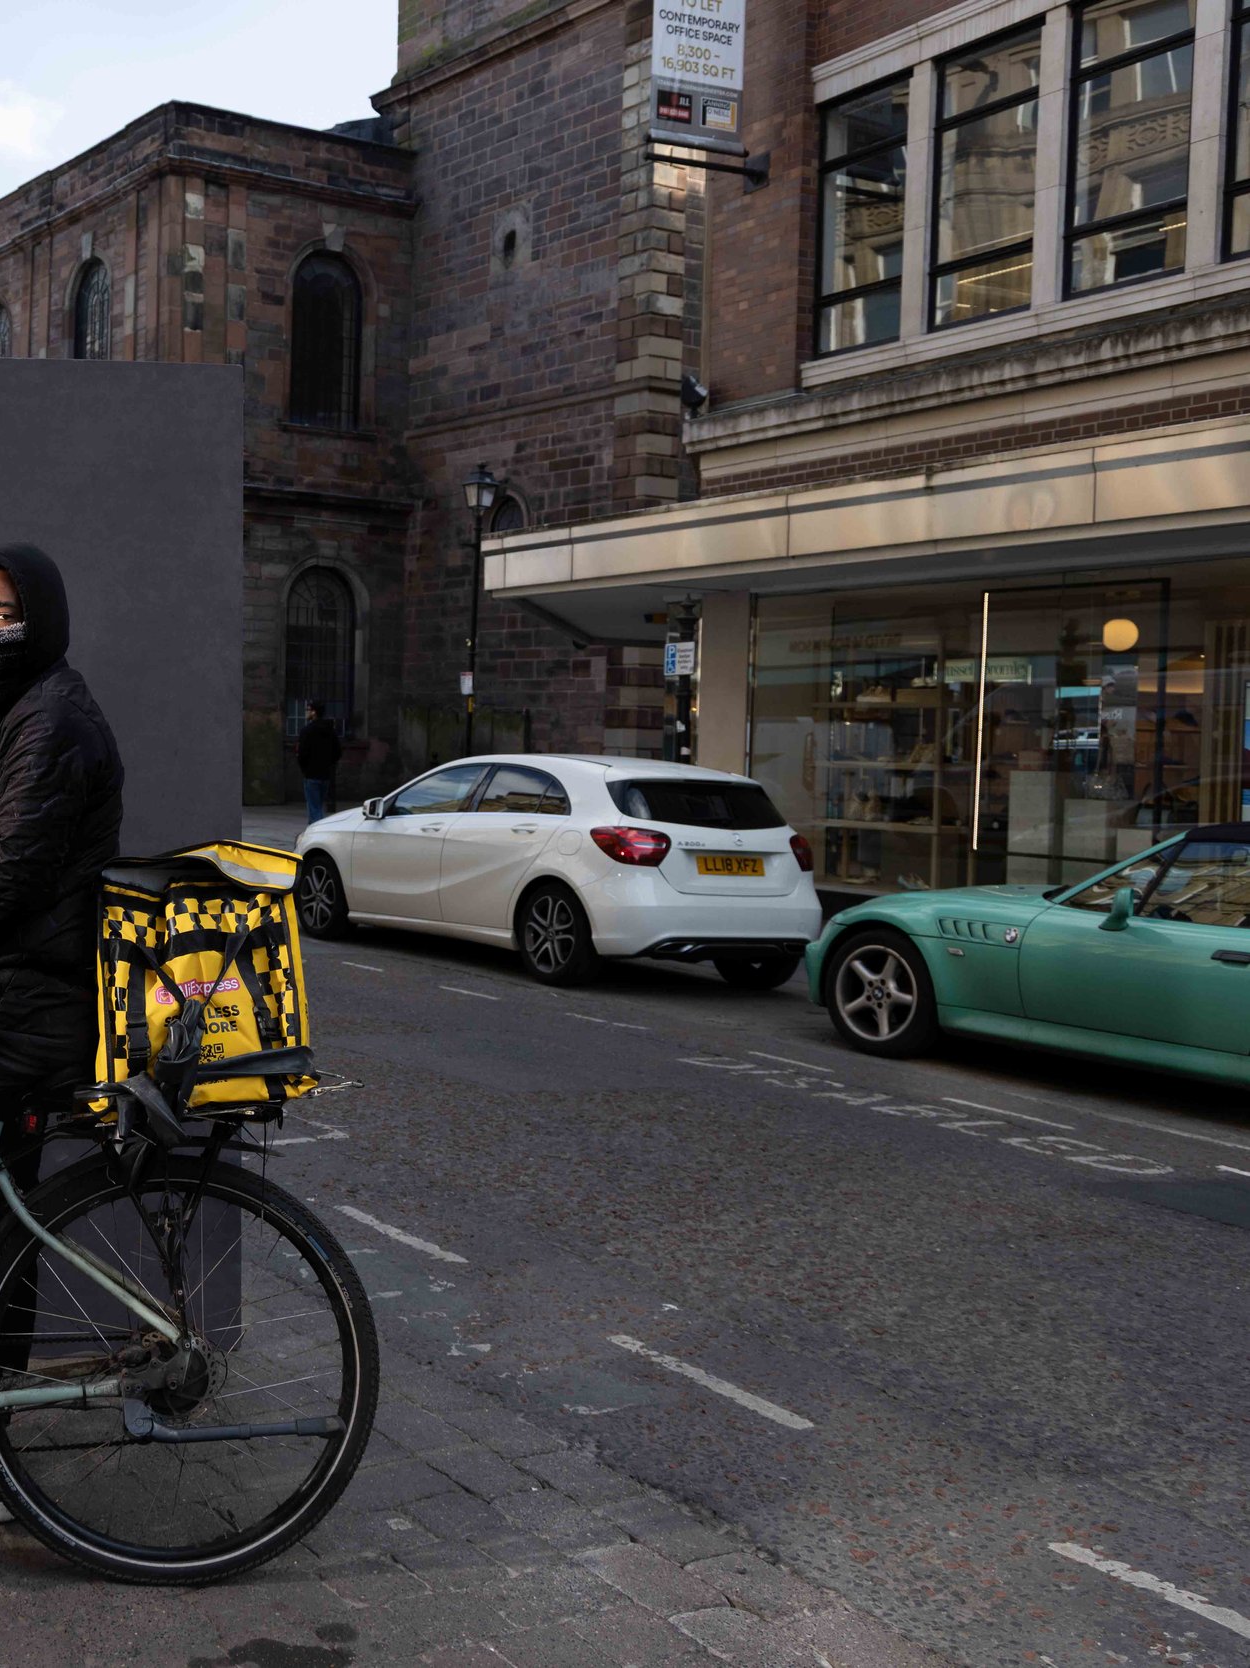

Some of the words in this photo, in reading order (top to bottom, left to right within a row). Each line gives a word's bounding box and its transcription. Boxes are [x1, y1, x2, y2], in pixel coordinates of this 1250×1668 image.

[700, 0, 722, 13] LET
[659, 9, 740, 33] CONTEMPORARY
[666, 24, 700, 40] OFFICE
[702, 31, 733, 46] SPACE
[677, 43, 711, 60] 8,300
[661, 56, 699, 74] 16,903
[702, 63, 719, 77] SQ
[721, 66, 735, 80] FT
[703, 856, 734, 872] LL18
[736, 858, 759, 873] XFZ
[207, 1005, 240, 1019] LESS
[676, 1056, 1175, 1175] DISABLED
